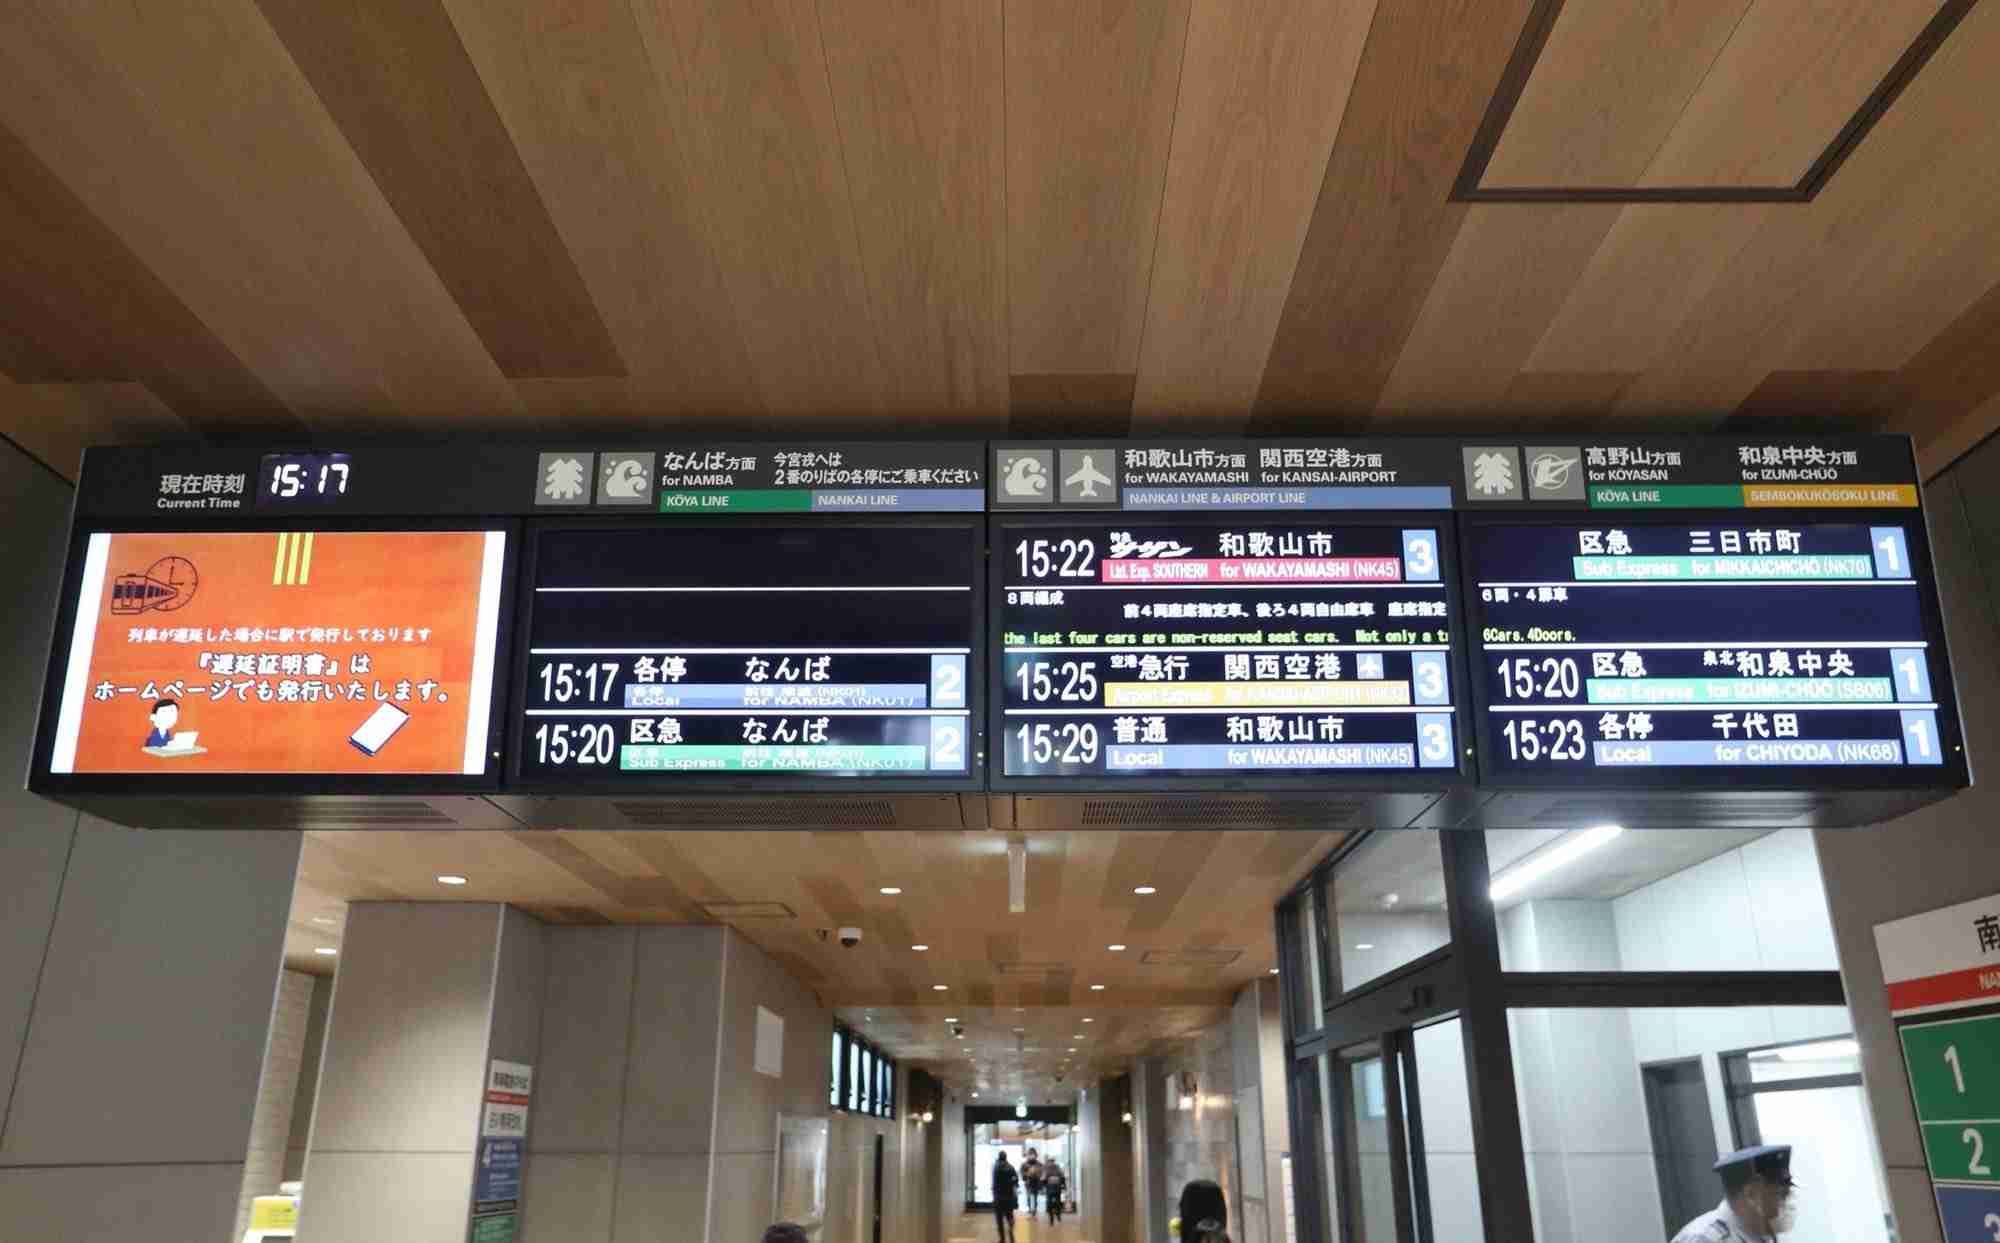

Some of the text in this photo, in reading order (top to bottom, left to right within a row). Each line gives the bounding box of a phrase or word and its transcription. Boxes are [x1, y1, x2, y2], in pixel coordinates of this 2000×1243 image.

[664, 452, 757, 472] なんば方面
[774, 452, 842, 468] 今宮戎へは
[1124, 448, 1246, 469] 和歌山市方面
[1260, 448, 1382, 469] 関西空港方面
[1585, 447, 1681, 467] 高野山方面
[1739, 447, 1857, 466] 和泉中央方面
[159, 473, 245, 494] 現在時刻
[662, 475, 734, 486] for NAMBA
[774, 469, 979, 486] 2番のりばの各停にご乗車ください
[1125, 472, 1249, 483] for WAKAYAMASHI
[1262, 471, 1397, 483] for KANSAI-AIRPORT
[1588, 470, 1606, 481] for
[1742, 469, 1758, 480] for
[157, 497, 241, 509] Current Time
[702, 496, 729, 506] LINE
[818, 495, 898, 506] NANKAI LINE
[1129, 492, 1305, 505] NANKAI LINE & AIRPORT LINE
[1633, 490, 1662, 502] LINE
[1871, 489, 1900, 502] LINE
[1218, 531, 1334, 557] 和歌山市
[1578, 530, 1633, 555] 区急
[1688, 530, 1802, 555] 三日市町
[1879, 535, 1900, 572] 1
[1015, 539, 1095, 578] 15:22
[1219, 559, 1400, 578] for WAKAYAMASHI (NK45)
[1408, 538, 1434, 575] 3
[1583, 559, 1614, 577] Sub
[1692, 558, 1712, 576] for
[128, 626, 433, 643] 列車が遅延した場合に駅で発行しております
[1004, 632, 1026, 645] the
[1033, 632, 1062, 645] last
[1069, 631, 1099, 645] four
[1105, 633, 1137, 645] cars
[1142, 633, 1166, 644] are
[1171, 631, 1262, 644] non-reserved
[1268, 631, 1299, 643] seat
[1304, 632, 1340, 643] cars.
[1355, 629, 1380, 643] Not
[1385, 629, 1417, 645] only
[1422, 631, 1431, 643] a
[633, 656, 688, 682] 各停
[745, 656, 832, 682] なんば
[1110, 653, 1190, 681] 空港急行
[1223, 653, 1342, 681] 関西空港
[1592, 651, 1648, 677] 区急
[1703, 650, 1856, 677] 泉北和泉中央
[1899, 657, 1921, 694] 1
[94, 678, 449, 702] ホームページでも発行いたします。
[540, 663, 620, 704] 15:17
[935, 662, 960, 701] 2
[1016, 661, 1098, 702] 15:25
[1418, 661, 1443, 699] 3
[1498, 658, 1580, 699] 15:20
[630, 717, 684, 744] 区急
[742, 717, 830, 744] なんば
[1113, 716, 1168, 744] 普通
[1226, 715, 1345, 743] 和歌山市
[1598, 712, 1654, 740] 各停
[1712, 713, 1799, 739] 千代田
[1908, 719, 1932, 757] 1
[535, 724, 615, 764] 15:20
[934, 726, 960, 762] 2
[1017, 723, 1099, 763] 15:29
[1422, 723, 1448, 760] 3
[1503, 719, 1587, 761] 15:23
[1716, 742, 1899, 763] for CHIYODA (NK68)
[1113, 750, 1164, 766] Local
[1227, 748, 1413, 766] for WAKAYAMASHI (NK45)
[1602, 745, 1652, 763] Local
[1943, 1044, 1966, 1094] 1
[1962, 1127, 1991, 1176] 2
